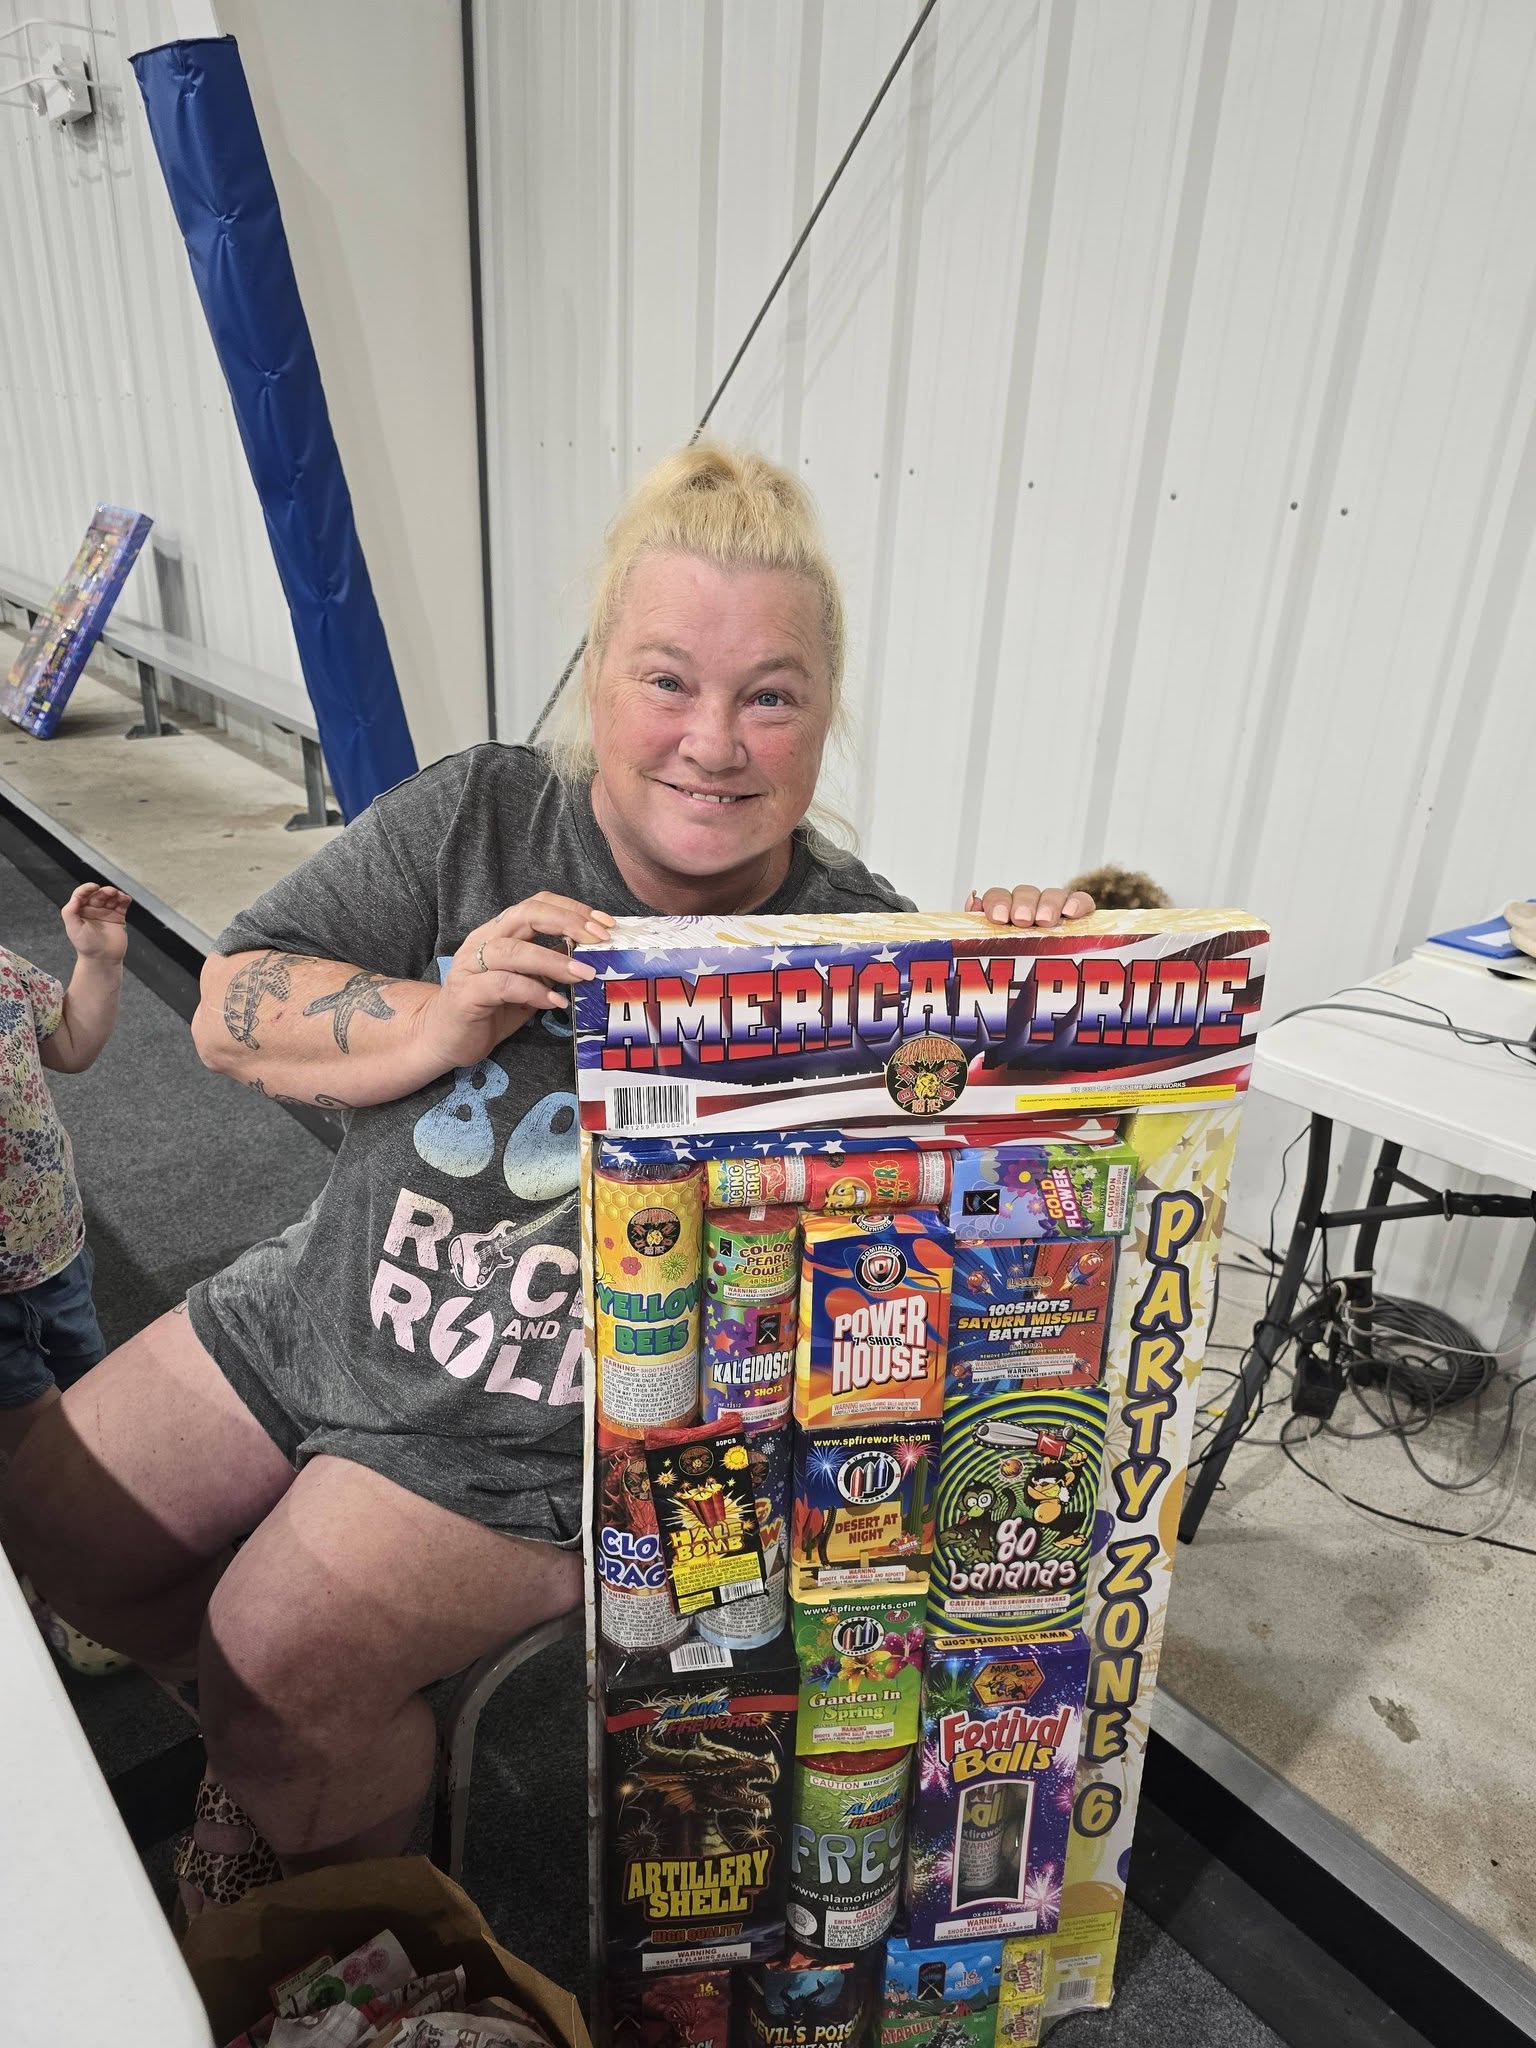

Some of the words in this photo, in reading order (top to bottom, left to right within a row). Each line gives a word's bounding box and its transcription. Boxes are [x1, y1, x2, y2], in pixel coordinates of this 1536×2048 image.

[602, 958, 1015, 1071] AMERICAN
[1030, 958, 1251, 1047] PRIDE
[1040, 1179, 1064, 1219] GOLD
[1051, 1168, 1083, 1229] FLOWER
[1106, 1177, 1117, 1218] CAUTION
[739, 1243, 793, 1258] COLOR
[746, 1253, 789, 1266] PEARL
[860, 1245, 901, 1261] DOMINATOR
[734, 1261, 790, 1276] FLOWER
[759, 1275, 784, 1284] SHOTS
[595, 1277, 702, 1323] YELLOW
[988, 1299, 1071, 1317] 100SHOTS
[501, 1318, 560, 1340] AND
[834, 1295, 928, 1348] POWER
[957, 1315, 1026, 1330] SATURN
[1030, 1309, 1097, 1326] MISSILE
[614, 1319, 690, 1356] BEES
[853, 1336, 860, 1346] 7
[868, 1336, 903, 1347] SHOTS
[987, 1324, 1065, 1342] BATTERY
[1112, 1189, 1204, 1523] PARTY
[832, 1342, 928, 1395] HOUSE
[744, 1390, 751, 1398] 9
[754, 1384, 783, 1398] SHOTS
[834, 1402, 859, 1411] WARNING
[813, 1433, 931, 1447] www.spfireworks.com
[834, 1517, 881, 1534] DESERT
[883, 1513, 899, 1527] AT
[601, 1526, 662, 1562] CLO
[669, 1521, 745, 1549] HALE
[848, 1528, 884, 1544] NIGHT
[996, 1516, 1037, 1564] go
[675, 1536, 744, 1564] BOMB
[948, 1558, 1077, 1593] bananas
[803, 1600, 917, 1616] www.spfireworks.com
[894, 1610, 902, 1618] 7
[942, 1631, 1069, 1647] www.oxfireworks.com
[1086, 1535, 1160, 1763] ZONE
[990, 1664, 1020, 1674] MAD
[1015, 1668, 1036, 1678] OX
[660, 1698, 730, 1720] ALAMO
[808, 1692, 877, 1708] Garden
[883, 1690, 901, 1701] In
[823, 1705, 885, 1722] Spring
[666, 1714, 764, 1737] FIREWORKS
[941, 1708, 1071, 1763] Festival
[953, 1741, 1057, 1783] Balls
[812, 1777, 860, 1789] CAUTION
[1072, 1782, 1123, 1839] 6
[627, 1849, 769, 1901] ARTILLERY
[649, 1885, 748, 1918] SHELL
[856, 1897, 892, 1918] CAUTION
[947, 1927, 971, 1935] SHOOTS
[972, 1924, 997, 1932] FLAMING
[998, 1921, 1017, 1929] BALLS
[966, 1916, 1003, 1928] WARNING
[651, 1929, 686, 1944] HIGH
[686, 1923, 743, 1941] QUALITY
[677, 1948, 717, 1958] WARNING
[962, 1969, 978, 1980] 16
[693, 1989, 720, 1999] SHOTS
[699, 1983, 714, 1993] 16
[750, 2009, 808, 2045] DEVIL'S
